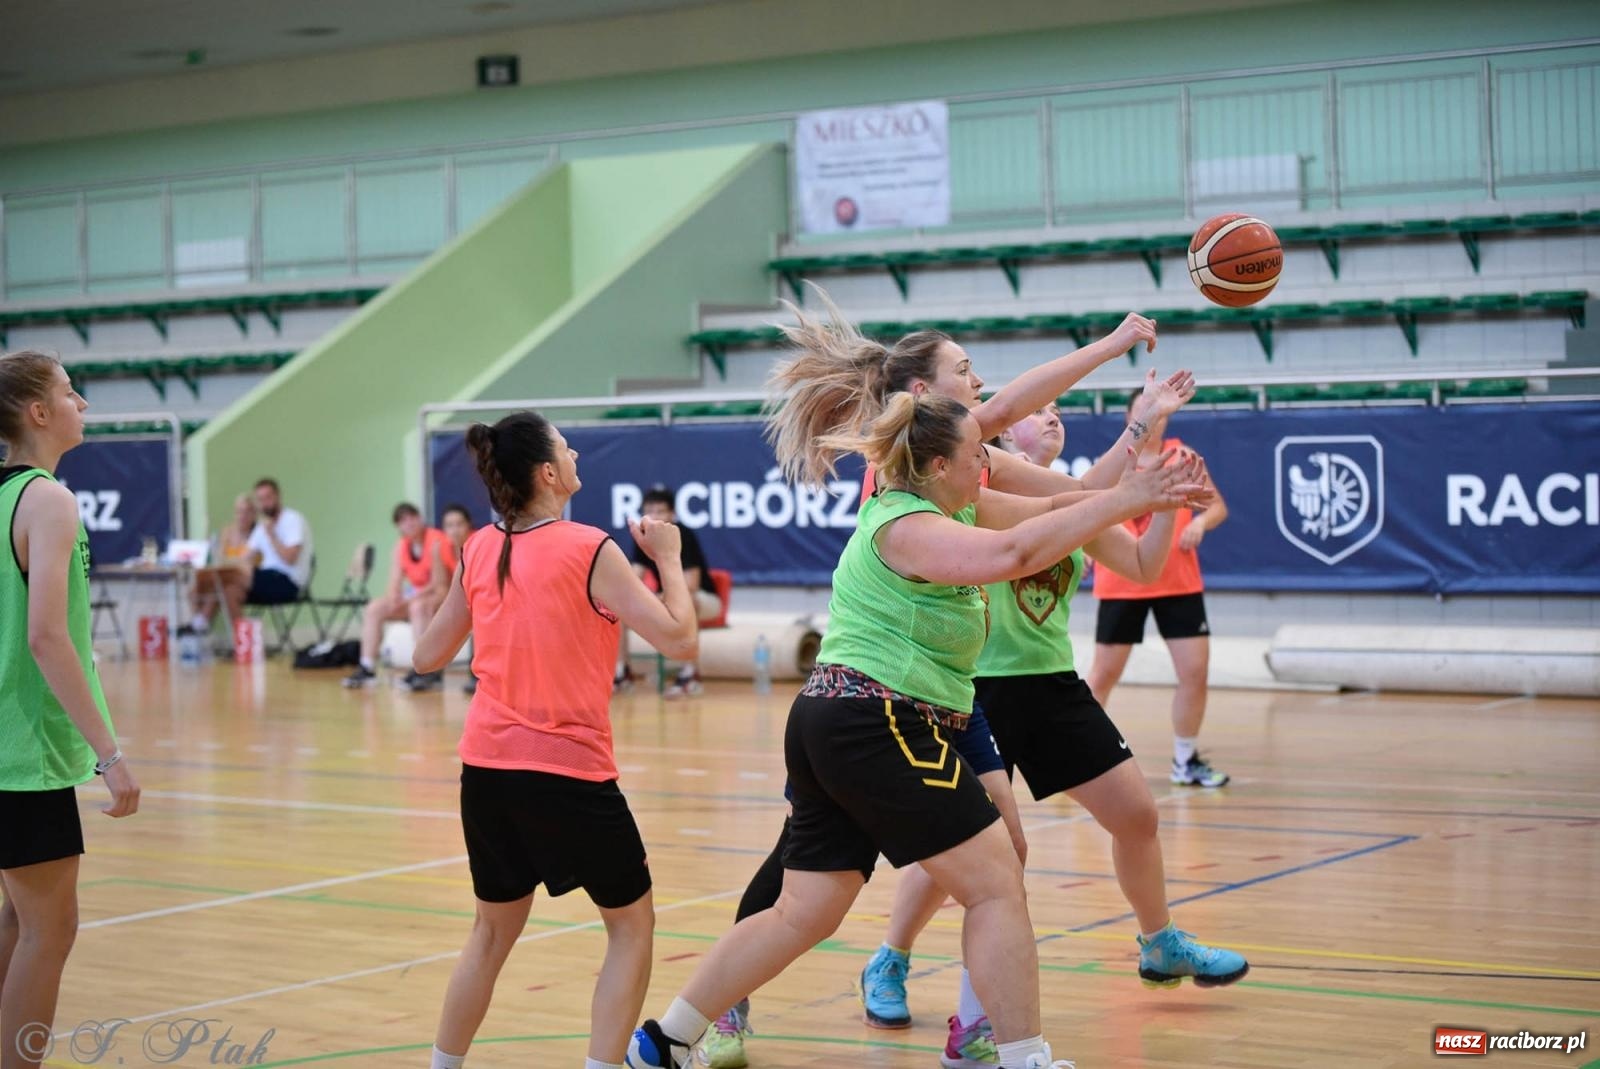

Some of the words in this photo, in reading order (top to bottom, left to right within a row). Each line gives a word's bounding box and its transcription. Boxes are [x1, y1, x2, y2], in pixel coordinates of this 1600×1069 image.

[1235, 255, 1281, 275] molten
[76, 490, 122, 531] RZ
[611, 466, 859, 529] RCIBÓRZ
[1447, 472, 1599, 526] RACI
